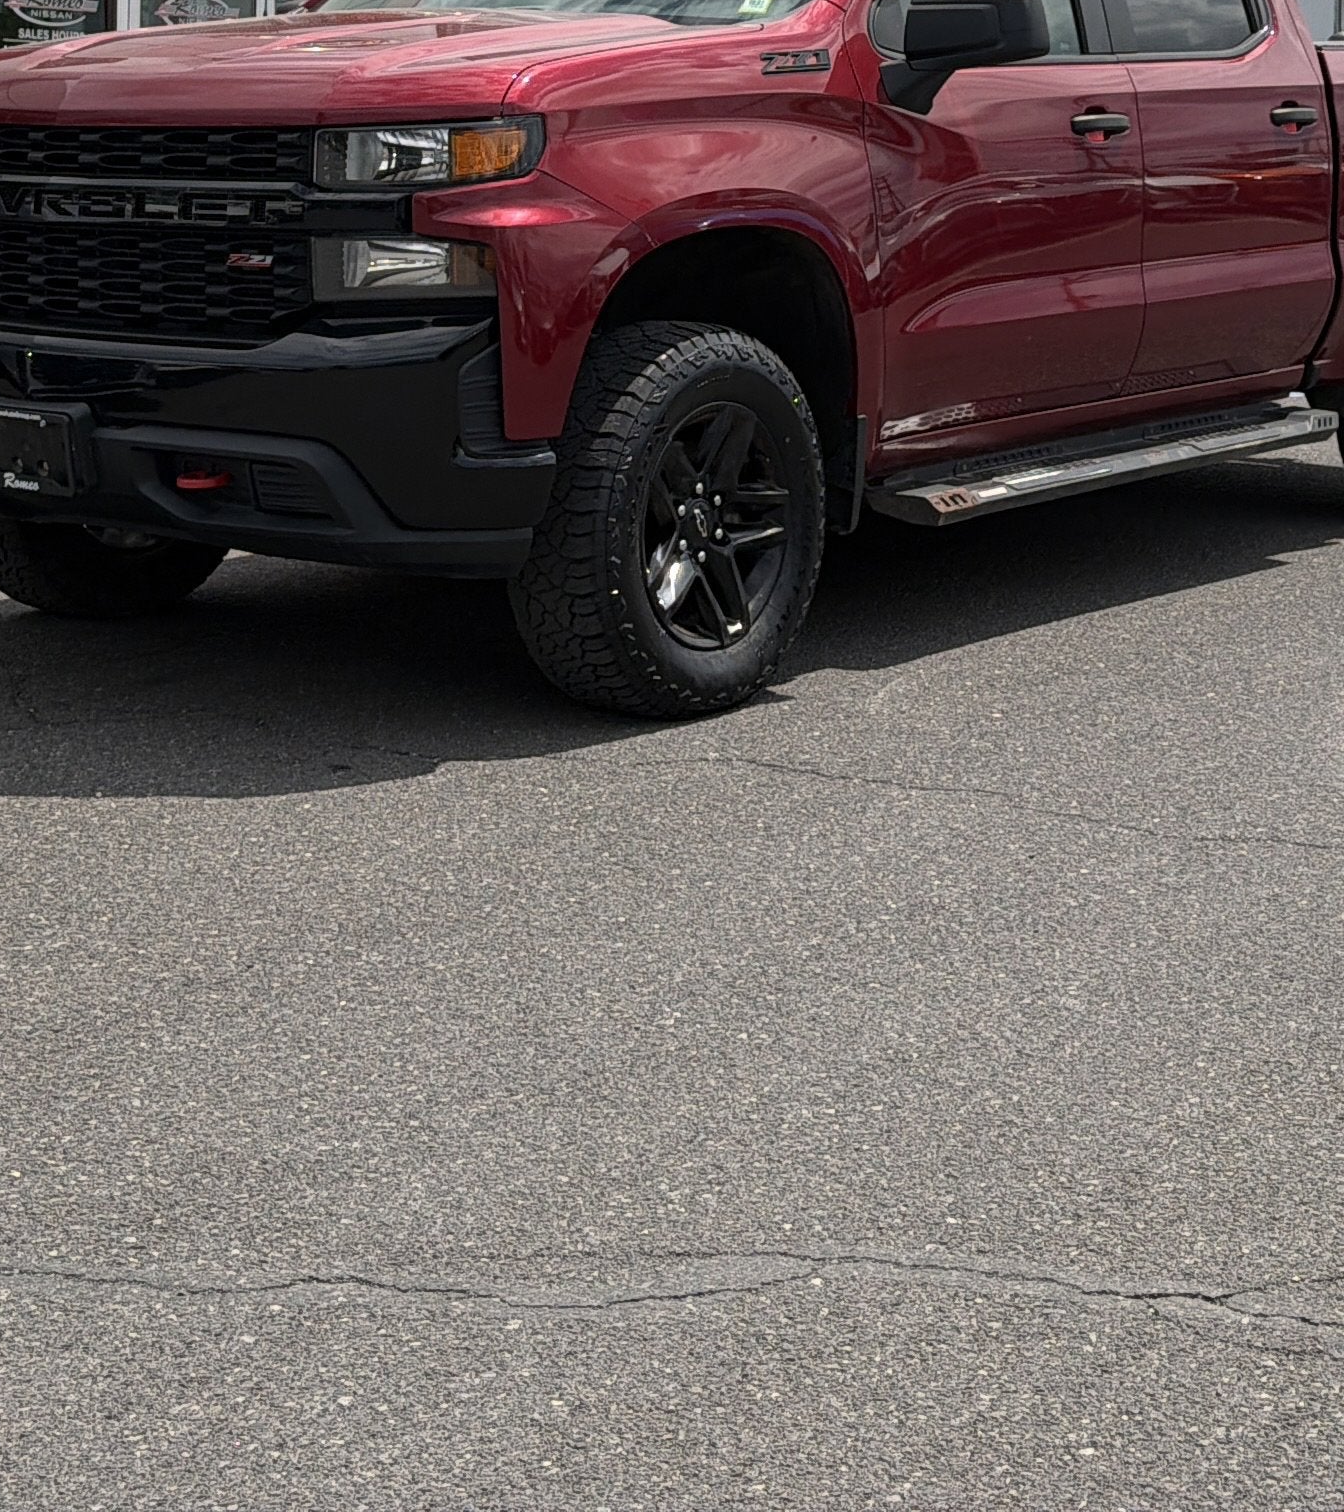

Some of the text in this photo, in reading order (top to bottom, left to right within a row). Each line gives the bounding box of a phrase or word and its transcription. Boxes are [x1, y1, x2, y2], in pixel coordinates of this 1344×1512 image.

[30, 9, 73, 20] NISSAN
[18, 28, 50, 40] SALES
[3, 471, 40, 492] Romeo
